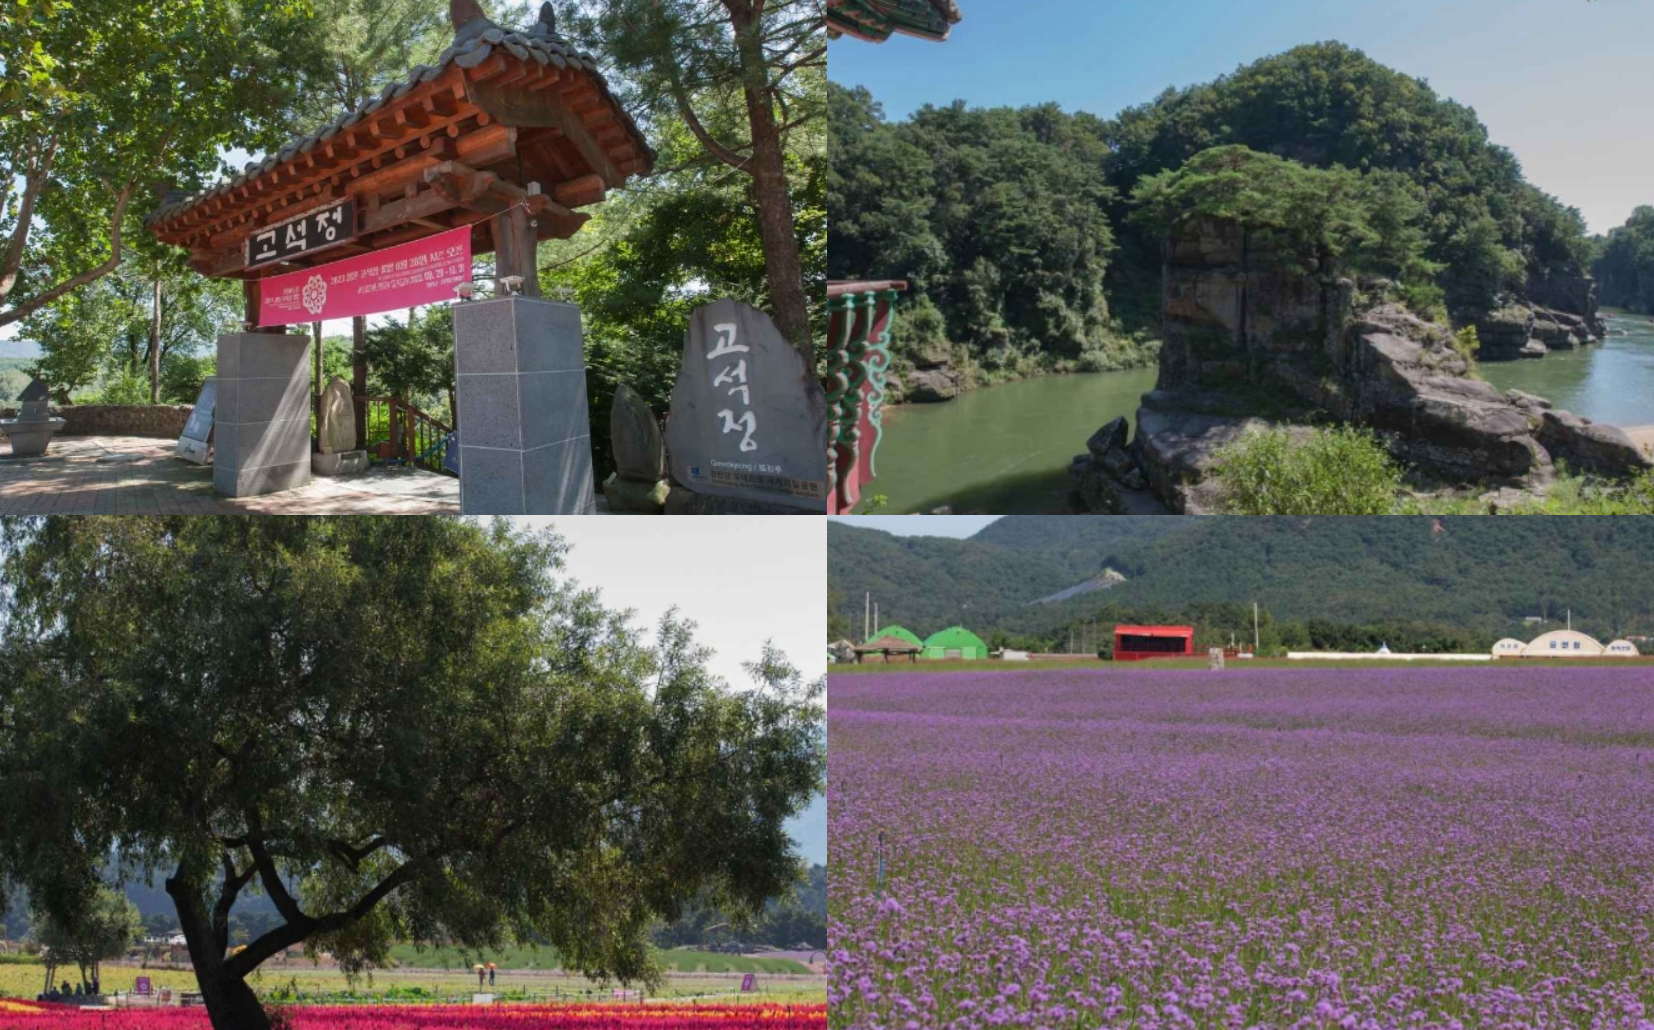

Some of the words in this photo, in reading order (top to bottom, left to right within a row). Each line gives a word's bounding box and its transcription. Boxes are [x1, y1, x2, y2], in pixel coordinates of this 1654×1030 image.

[255, 205, 343, 261] 고석정
[360, 266, 379, 278] 고석정
[706, 323, 758, 452] 고석정
